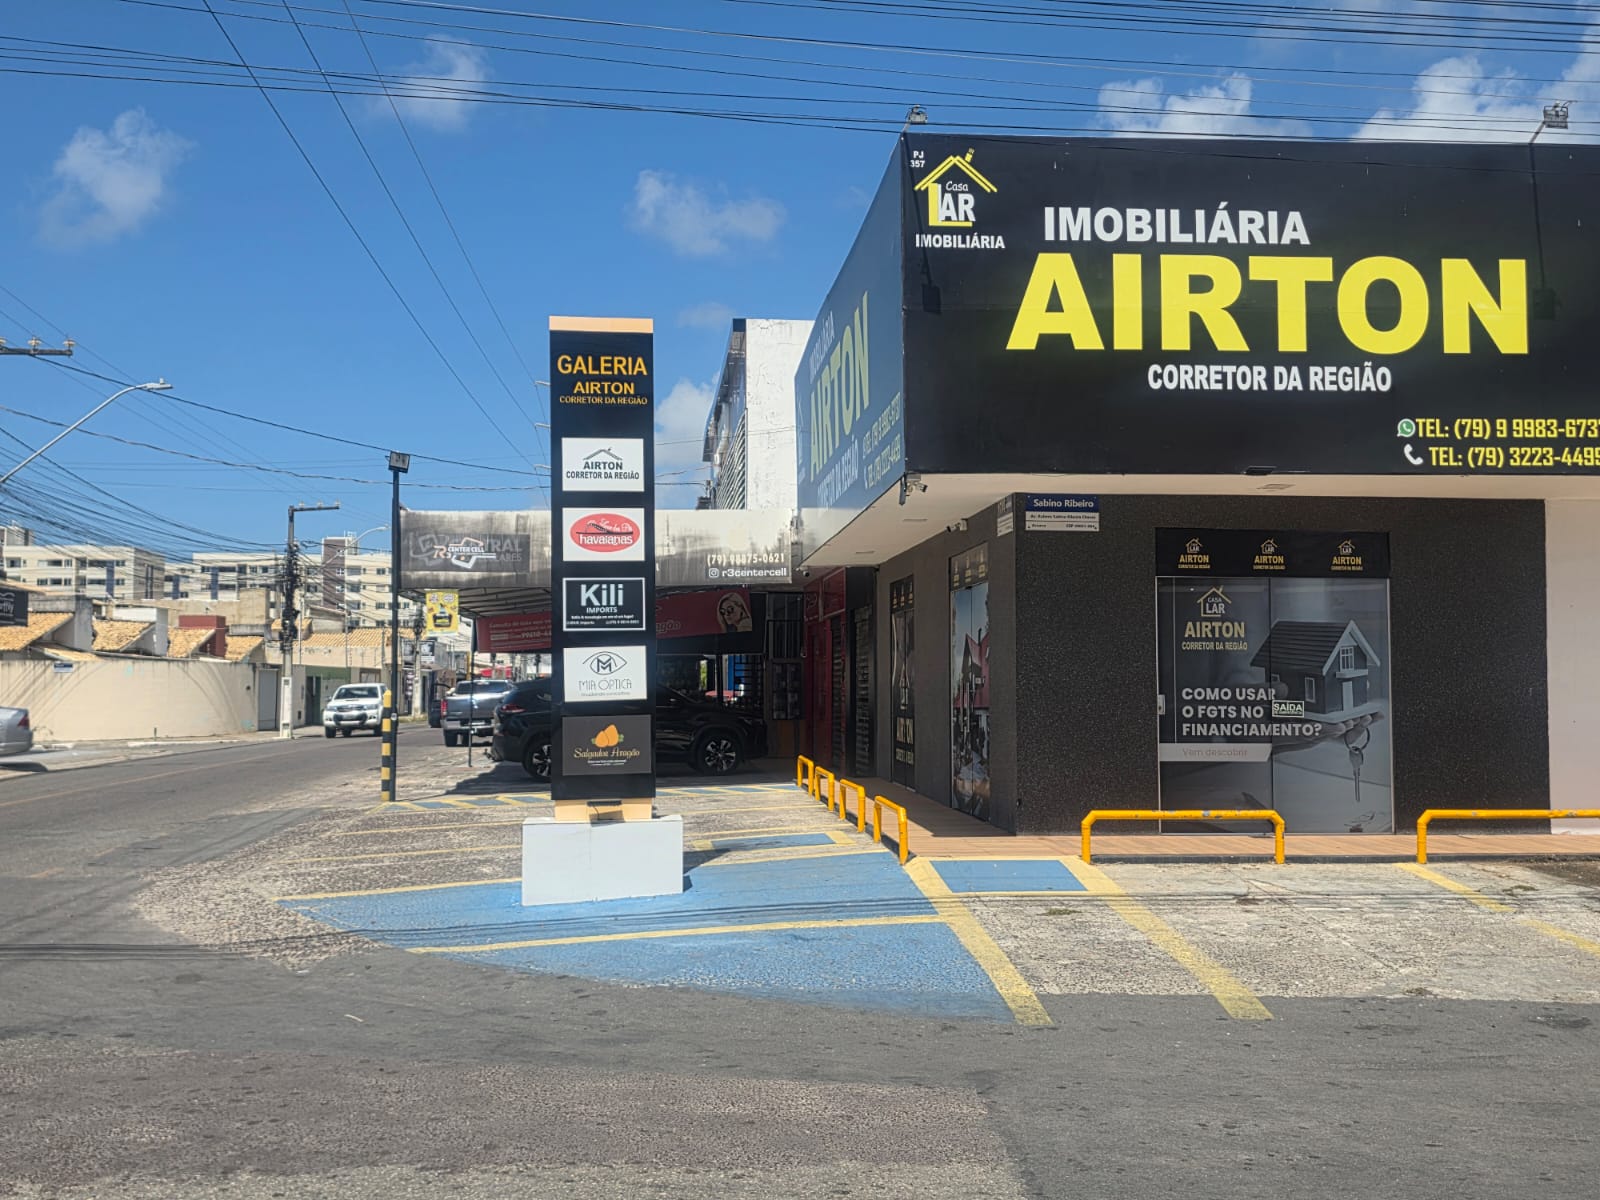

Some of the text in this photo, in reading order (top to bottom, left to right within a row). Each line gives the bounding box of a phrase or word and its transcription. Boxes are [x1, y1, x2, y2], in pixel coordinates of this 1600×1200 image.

[913, 150, 924, 159] PJ
[910, 160, 925, 168] 357
[945, 181, 968, 191] Casa
[1044, 201, 1311, 246] IMOBILIÁRIA
[915, 232, 1005, 249] IMOBILIÁRIA
[1006, 253, 1529, 355] AIRTON
[557, 355, 648, 376] GALERIA
[1147, 361, 1392, 392] CORRETOR DA REGIÃO
[573, 381, 635, 395] AIRTON
[810, 290, 870, 483] AIRTON
[559, 395, 603, 404] CORRETOR
[617, 396, 648, 405] REGIÃO
[1415, 418, 1600, 440] TEL: (79) 9 9983-673
[1429, 447, 1463, 466] TEL:
[1467, 447, 1504, 468] (79)
[583, 461, 623, 471] AIRTON
[566, 471, 602, 479] CORRETOR
[1033, 498, 1094, 508] Sabino Ribeiro
[580, 534, 633, 546] havaianas
[1179, 554, 1209, 563] AIRTON
[1254, 555, 1284, 564] AIRTON
[1332, 556, 1362, 565] AIRTON
[581, 583, 624, 607] Kili
[586, 606, 617, 614] IMPORTS
[1206, 602, 1225, 614] LAR
[1184, 621, 1245, 638] AIRTON
[1181, 641, 1214, 650] CORRETOR
[1215, 641, 1224, 650] DA
[1182, 687, 1275, 701] COMO USAR
[1182, 706, 1264, 719] O FGTS NO
[1182, 723, 1322, 737] FINANCIAMENTO?
